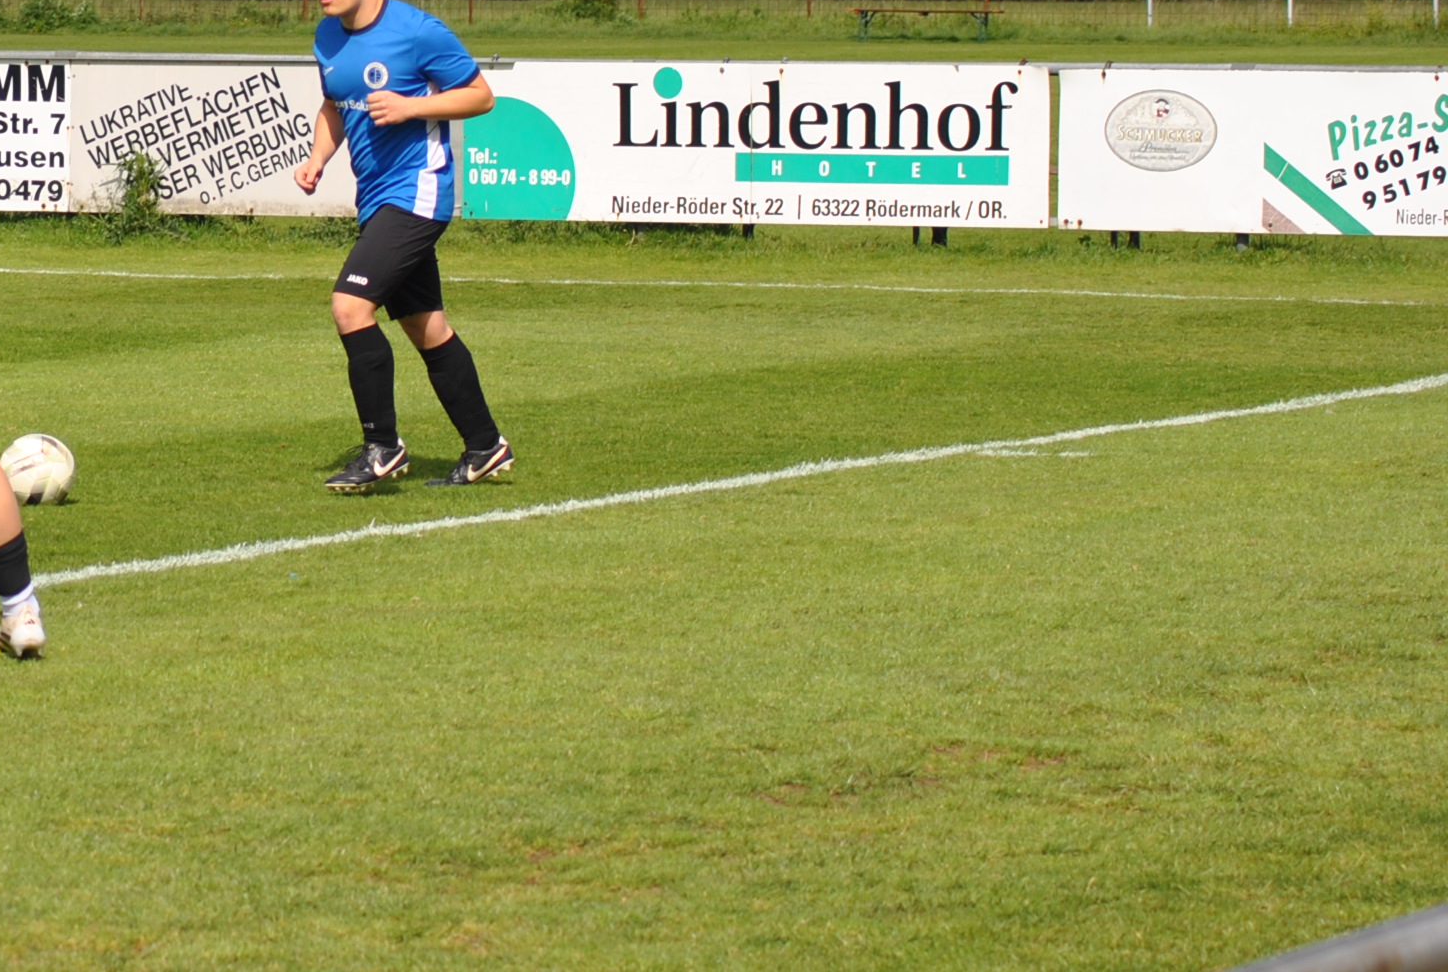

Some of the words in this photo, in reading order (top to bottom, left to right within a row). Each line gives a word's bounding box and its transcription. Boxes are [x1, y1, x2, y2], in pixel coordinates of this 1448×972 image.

[50, 113, 66, 135] 7
[79, 83, 193, 145] LUKRATIVE
[156, 91, 291, 168] VERMIETEN
[611, 68, 1019, 152] Lindenhof
[201, 113, 312, 179] WERBUNG
[1116, 124, 1203, 143] SCHMUCKER
[467, 147, 498, 165] Tel.:
[611, 195, 727, 216] Nieder-Röder
[731, 196, 760, 217] Str.
[764, 198, 784, 216] 22
[810, 198, 860, 218] 63322
[865, 198, 960, 219] Rödermark
[977, 200, 1008, 220] OR.
